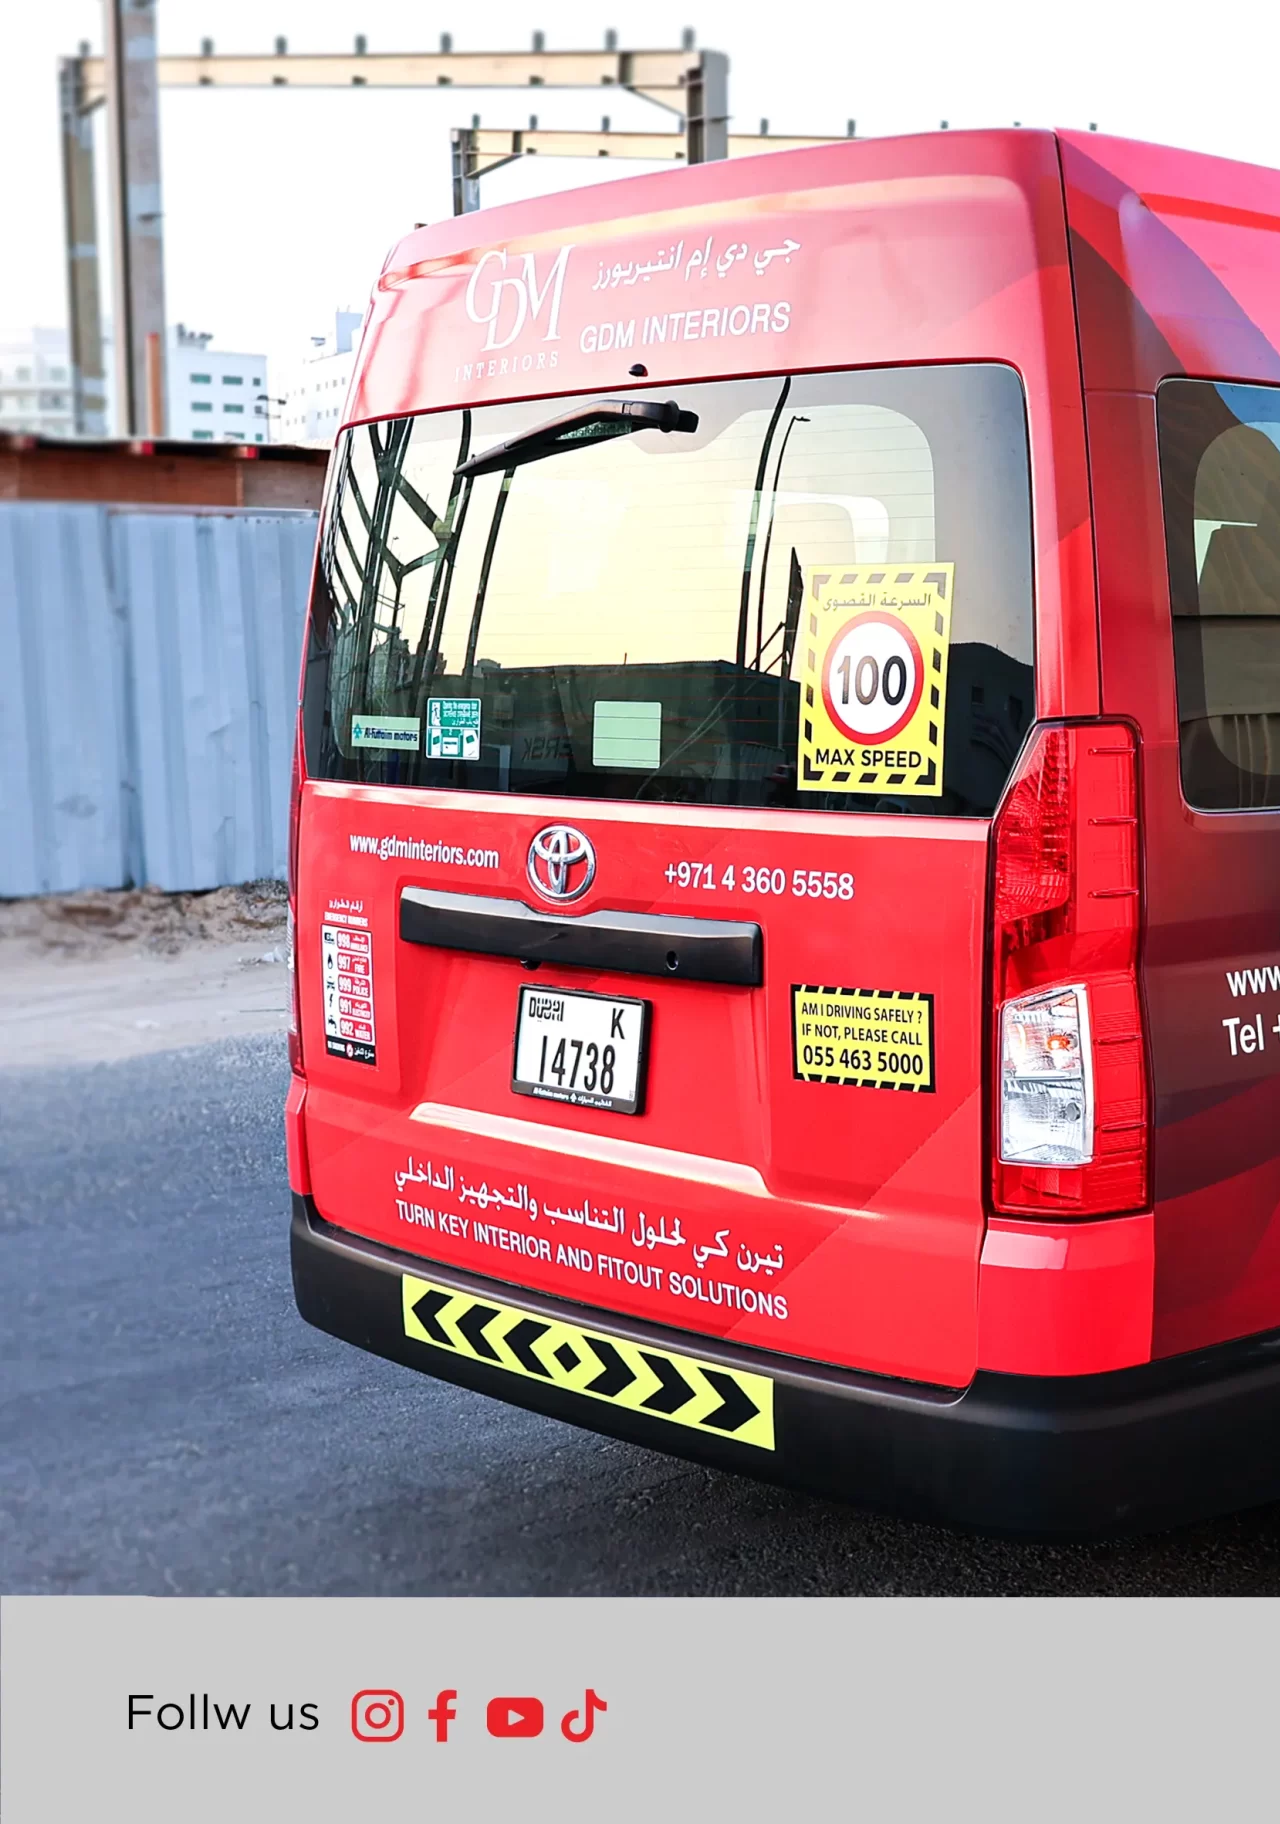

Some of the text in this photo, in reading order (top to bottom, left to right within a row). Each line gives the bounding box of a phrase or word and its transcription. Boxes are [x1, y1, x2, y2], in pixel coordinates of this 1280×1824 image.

[716, 239, 748, 278] دي
[753, 237, 801, 275] جي
[464, 244, 576, 352] GDM
[579, 301, 791, 354] GDM INTERIORS
[453, 351, 558, 383] INTERIORS
[880, 591, 931, 611] السرعة
[837, 655, 907, 706] 100
[393, 731, 418, 742] motors
[815, 748, 922, 769] MAX SPEED
[349, 832, 500, 869] www.gdminteriors.com
[664, 861, 855, 901] +971 4 360 5558
[611, 1008, 625, 1040] K
[801, 1001, 819, 1016] AM
[826, 1003, 871, 1021] DRIVING
[874, 1007, 914, 1024] SAFELY
[802, 1024, 922, 1046] IF NOT, PLEASE CALL
[1222, 1013, 1264, 1056] Tel
[539, 1035, 616, 1094] 14738
[803, 1044, 924, 1075] 055 463 5000
[394, 1157, 455, 1192] الداخلي
[458, 1176, 538, 1221] والتجهيز
[543, 1200, 625, 1235] التناسب
[395, 1199, 788, 1320] TURN KEY INTERIOR AND FITOUT SOLUTIONS
[693, 1230, 730, 1269] كي
[736, 1244, 784, 1277] تيرن
